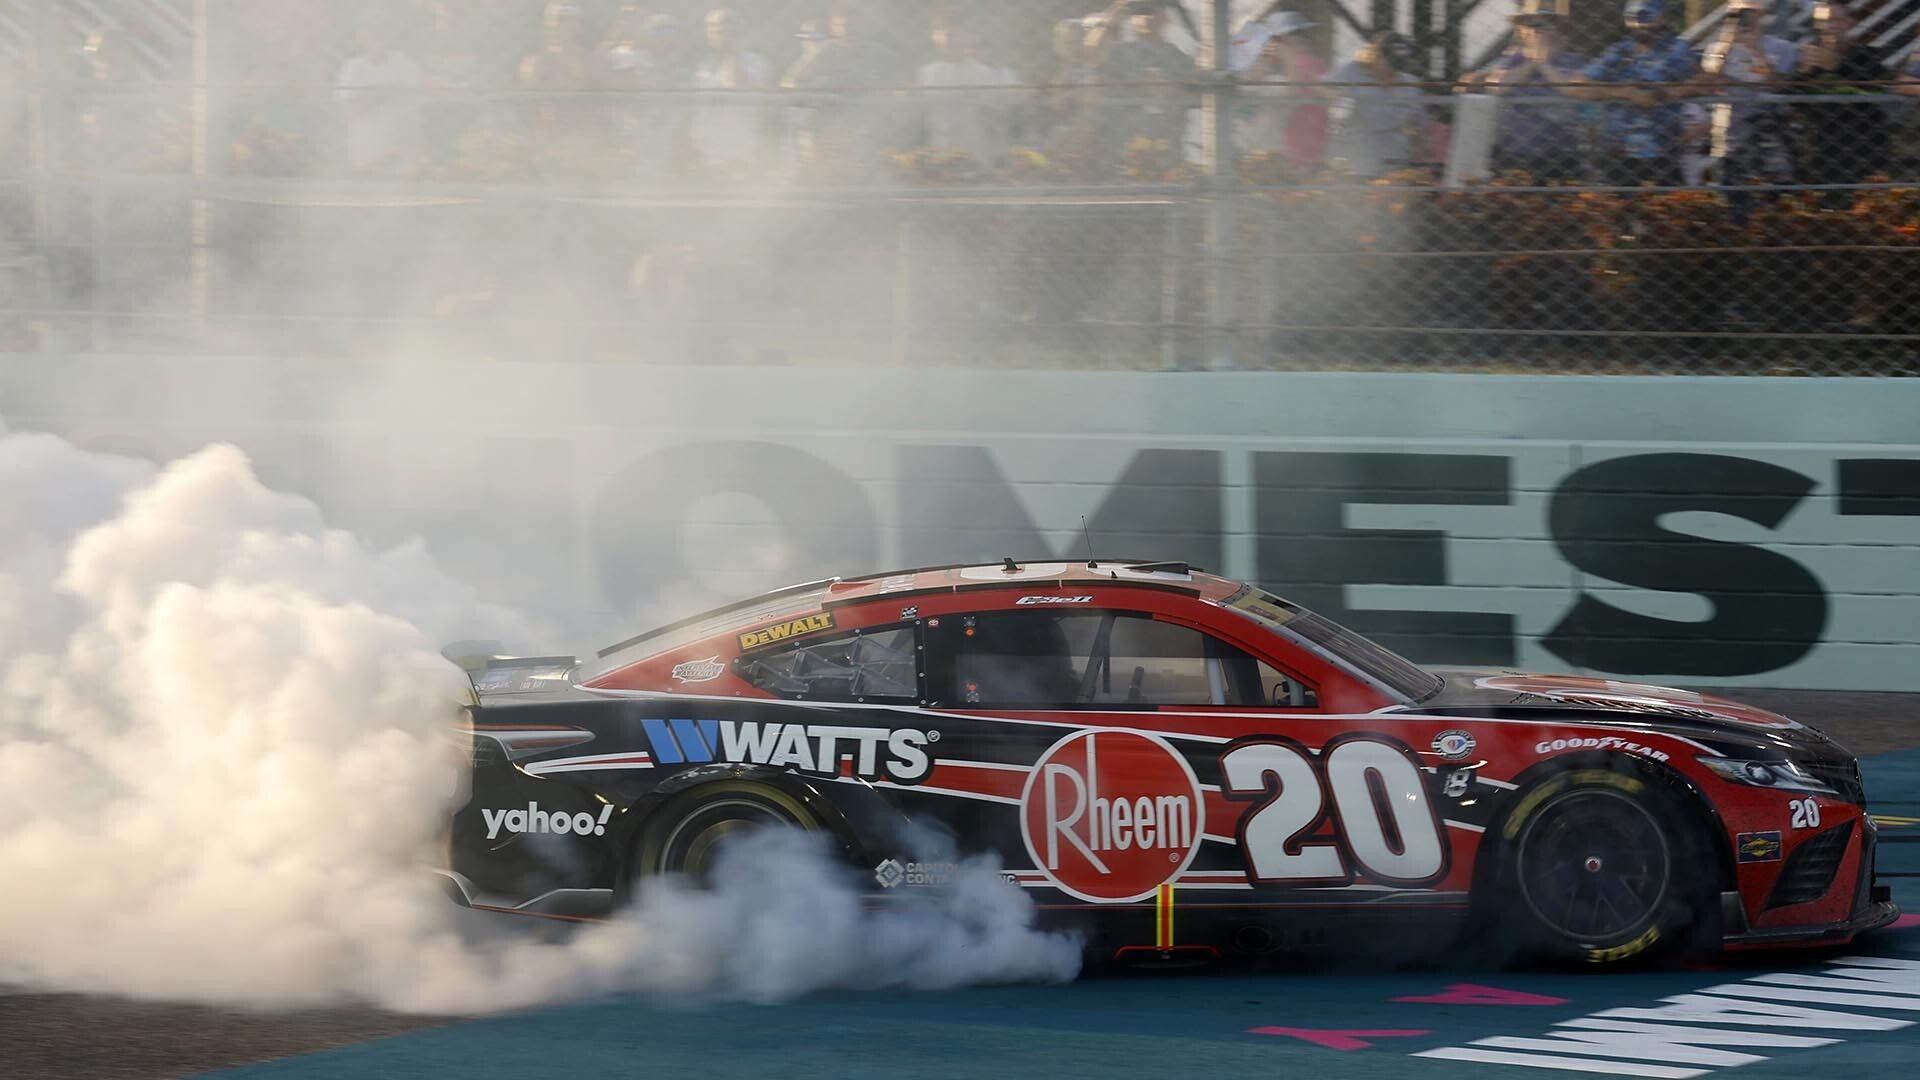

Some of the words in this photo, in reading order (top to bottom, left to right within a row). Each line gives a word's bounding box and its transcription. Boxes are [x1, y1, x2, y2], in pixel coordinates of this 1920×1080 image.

[484, 443, 1920, 676] OMES
[718, 721, 929, 780] WATTS
[1535, 736, 1671, 763] GOODYEAR
[480, 801, 616, 840] yahoo!
[1043, 733, 1191, 874] Rheem
[1221, 740, 1444, 880] 20
[1788, 799, 1821, 829] 20
[999, 873, 1022, 885] NC.
